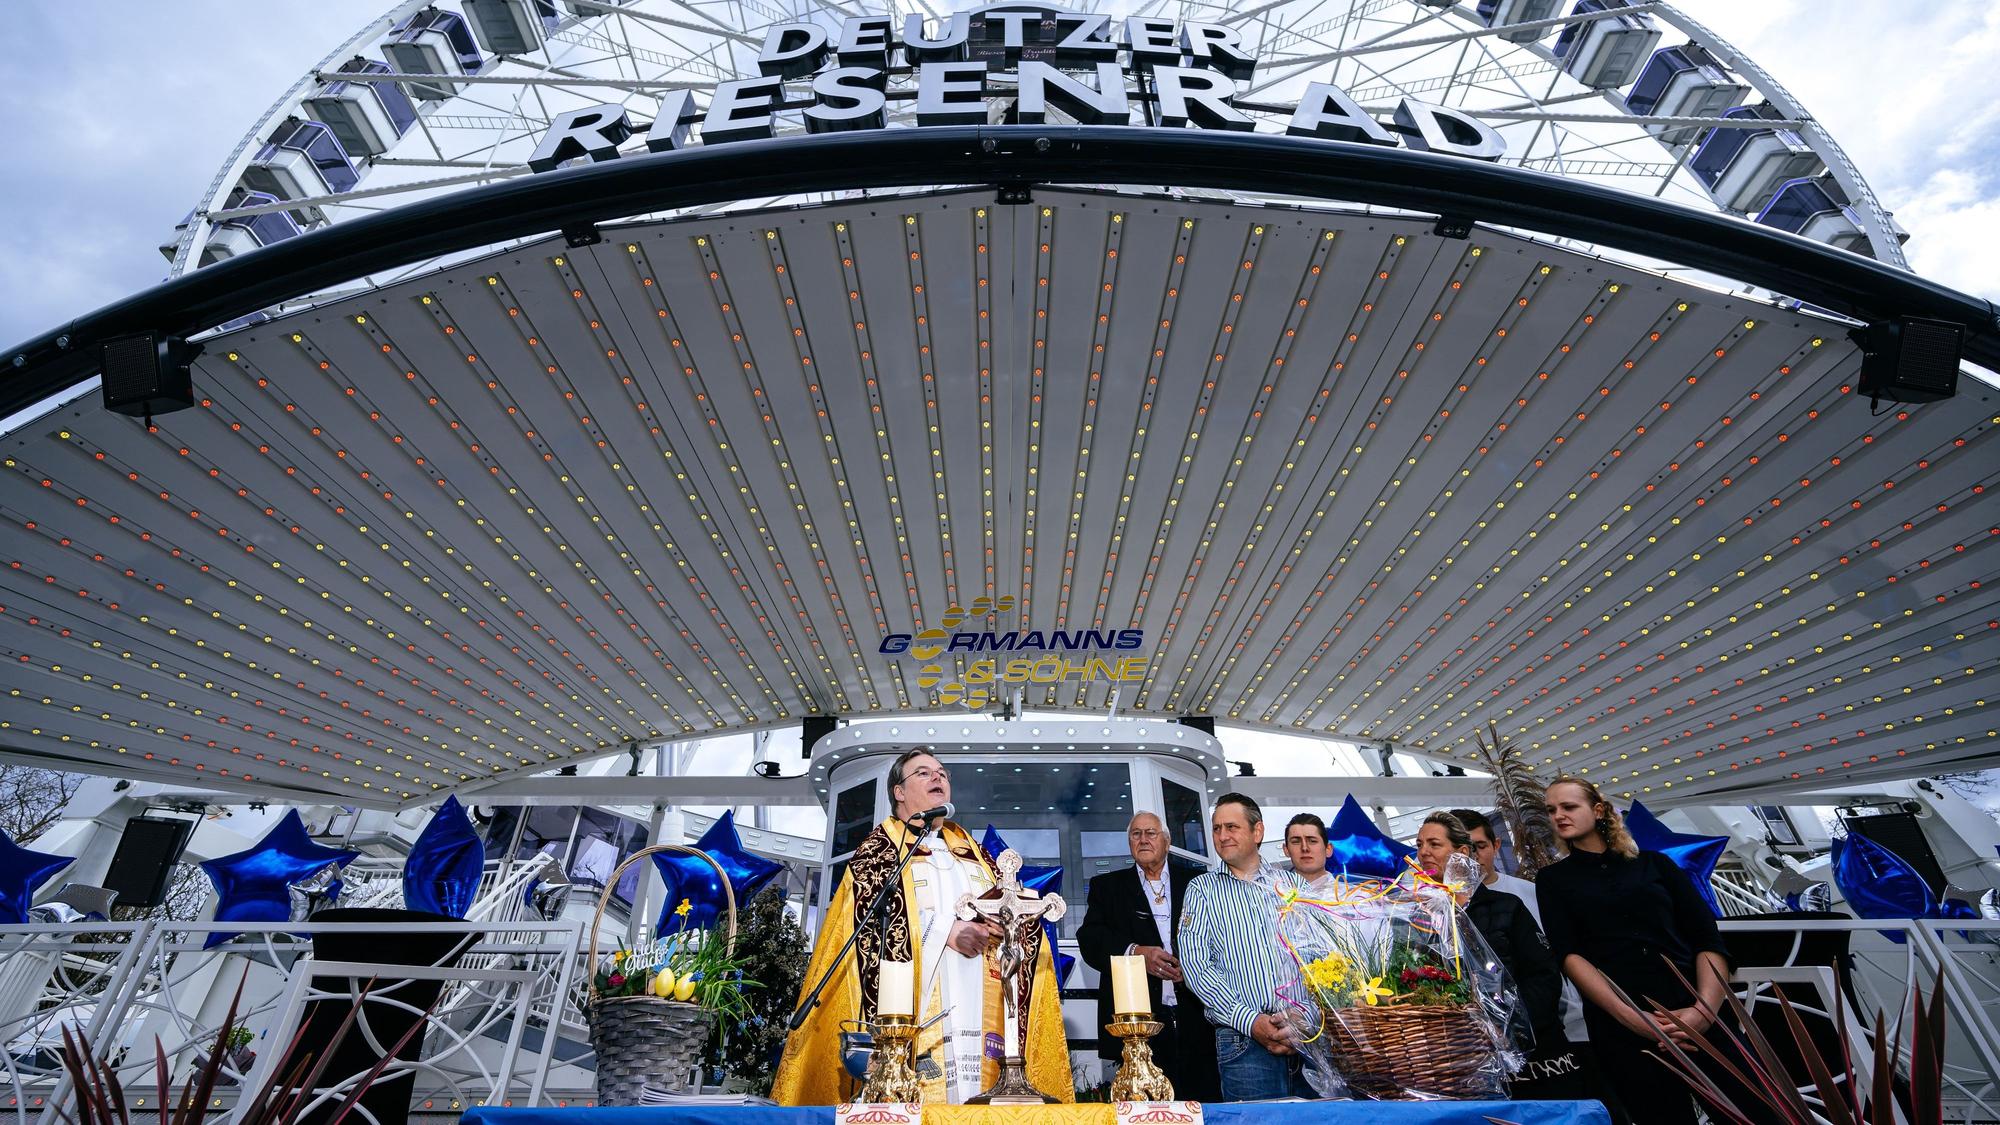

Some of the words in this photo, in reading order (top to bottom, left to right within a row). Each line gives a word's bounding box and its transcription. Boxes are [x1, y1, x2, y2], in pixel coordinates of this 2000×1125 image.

[758, 11, 1257, 63] DEUTZER
[528, 61, 1507, 166] RIESENRAD
[964, 660, 996, 684] &
[1001, 654, 1149, 683] SÖHNE
